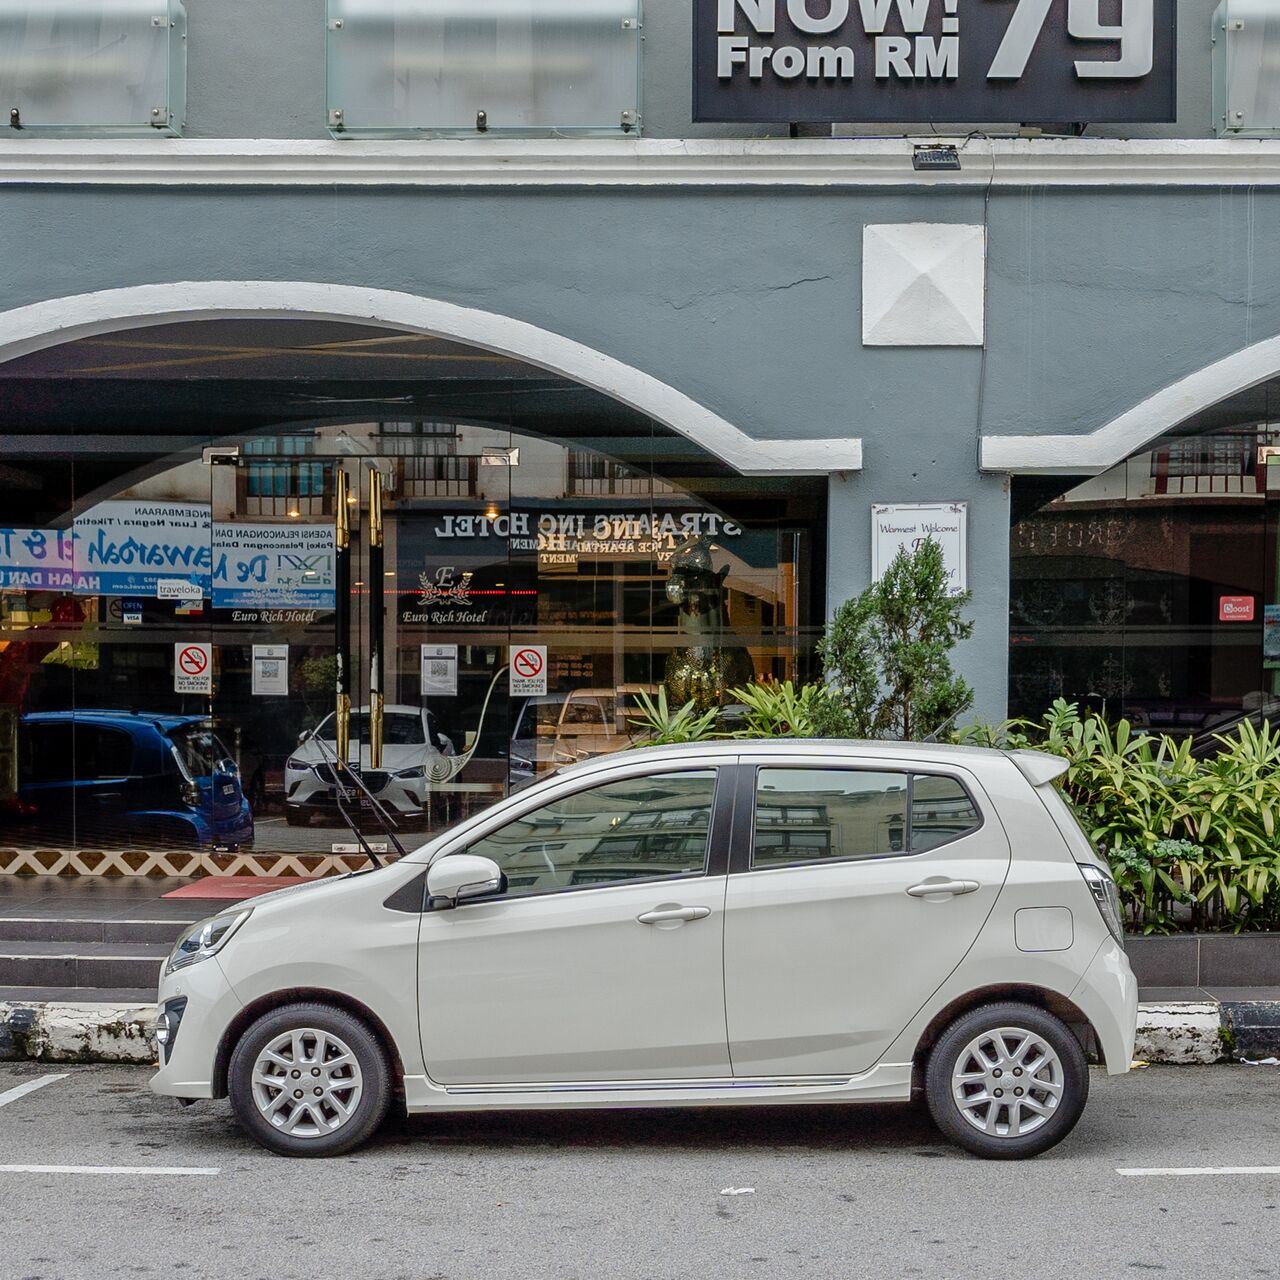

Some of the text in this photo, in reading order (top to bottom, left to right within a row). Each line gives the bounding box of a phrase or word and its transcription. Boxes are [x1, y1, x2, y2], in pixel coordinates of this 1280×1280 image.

[717, 36, 854, 79] From
[874, 36, 960, 79] RM
[880, 523, 959, 533] Warmest Welcome
[159, 585, 201, 595] traveloka
[232, 610, 317, 623] Euro Rich Hotel
[402, 610, 488, 624] Euro Rich Hotel
